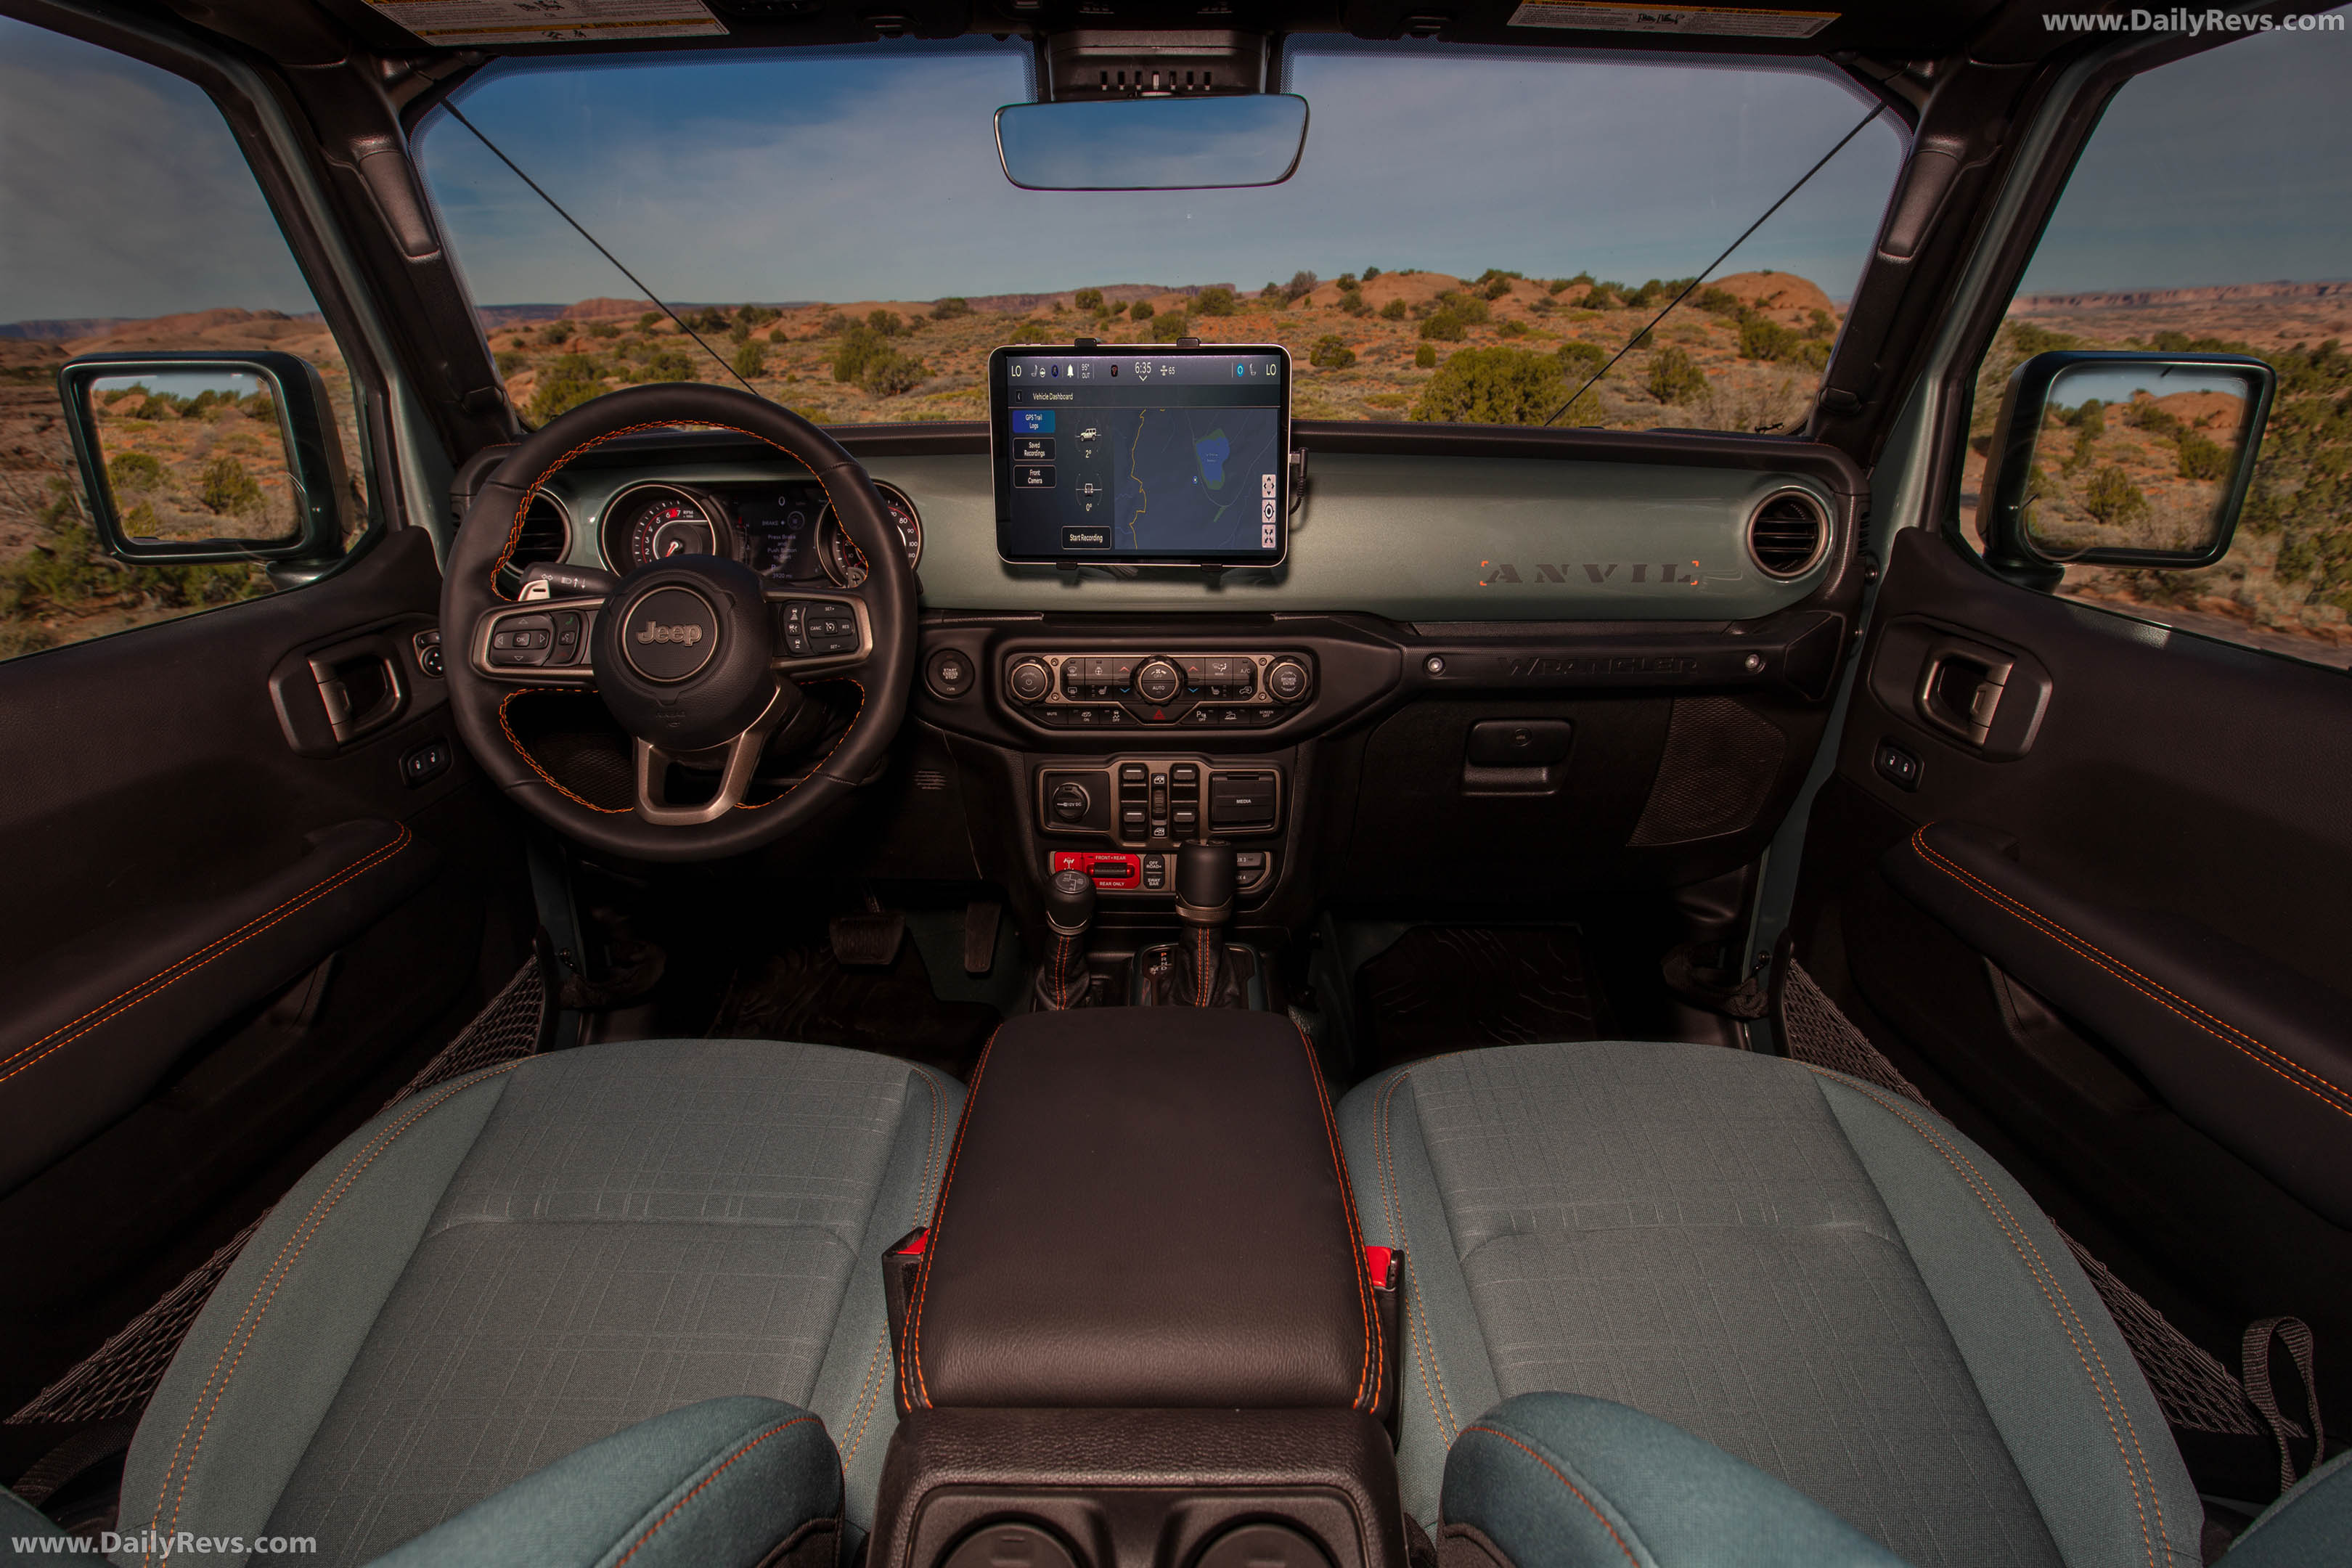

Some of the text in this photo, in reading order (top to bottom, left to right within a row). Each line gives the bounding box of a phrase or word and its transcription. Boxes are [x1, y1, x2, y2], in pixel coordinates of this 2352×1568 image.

[1011, 365, 1021, 377] LO
[1135, 362, 1151, 374] 6:35
[1168, 367, 1175, 375] 65
[1266, 364, 1276, 375] LO
[1081, 534, 1103, 543] Recording
[1486, 563, 1692, 584] ANVIL
[635, 620, 703, 648] Jeep
